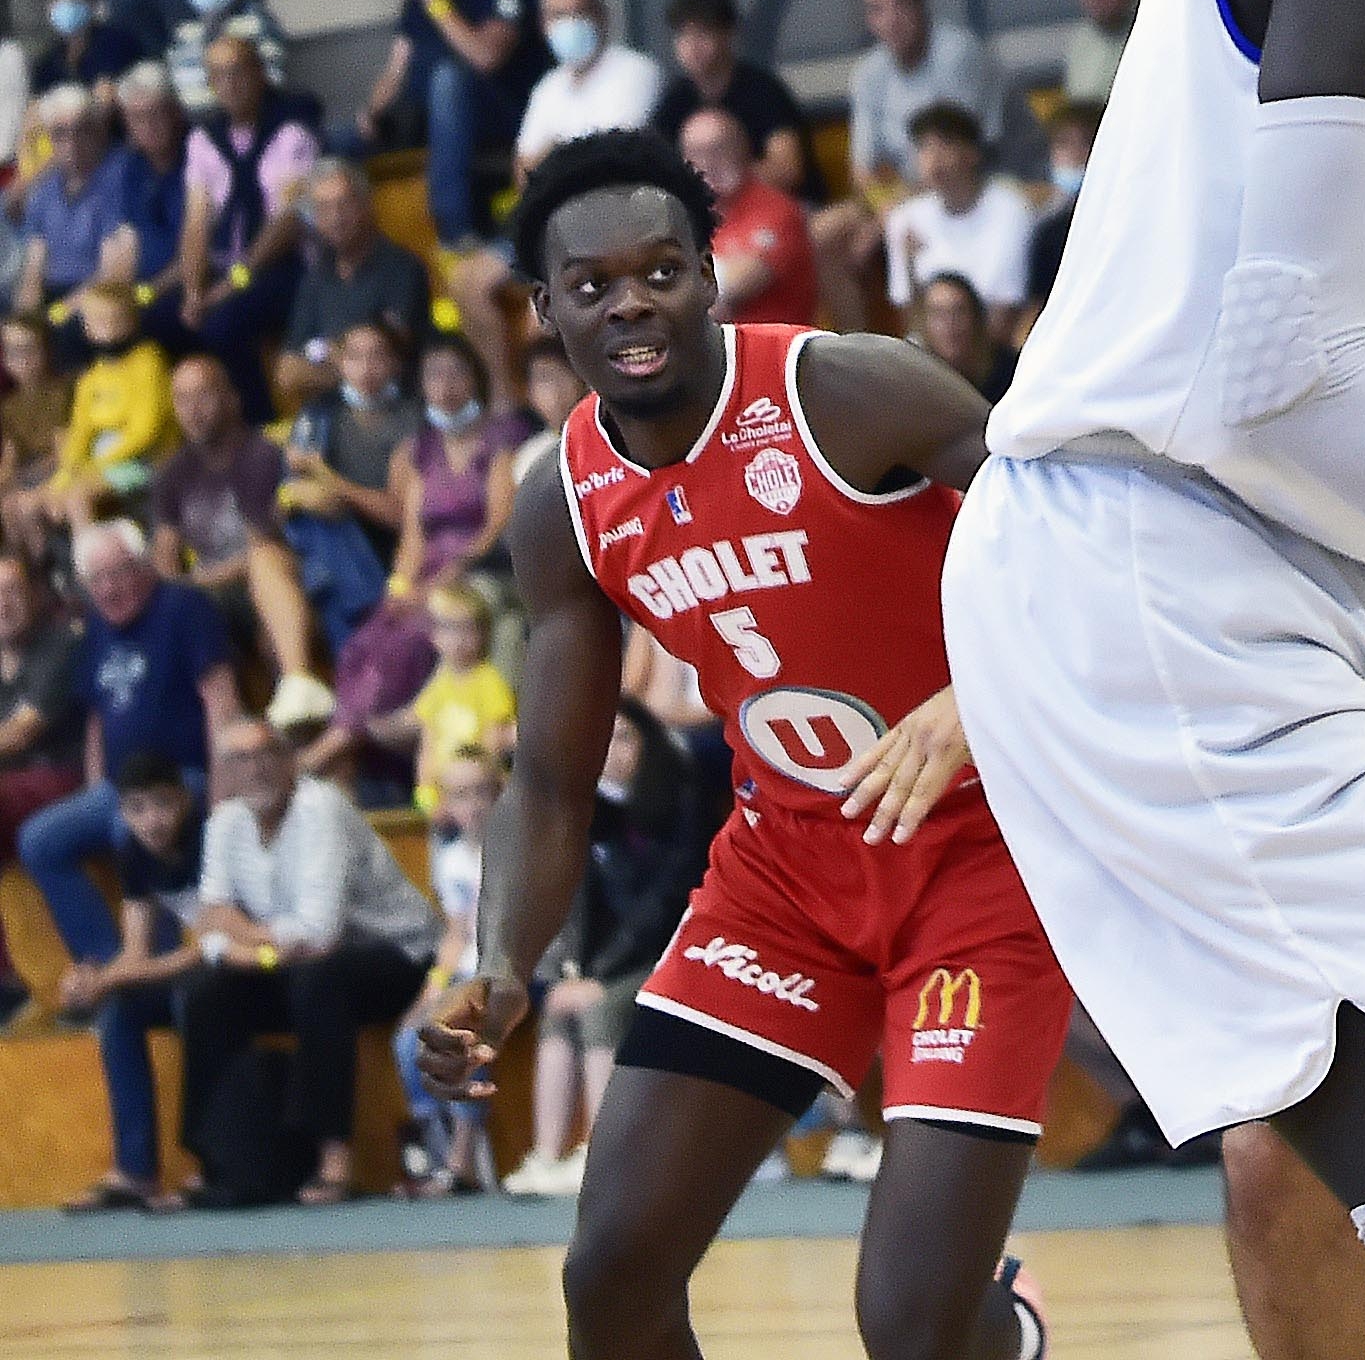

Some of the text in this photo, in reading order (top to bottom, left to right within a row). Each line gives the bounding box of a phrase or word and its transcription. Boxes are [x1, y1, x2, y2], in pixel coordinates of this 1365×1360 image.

[627, 529, 812, 620] CHOLET
[709, 606, 782, 679] 5
[765, 715, 853, 770] U
